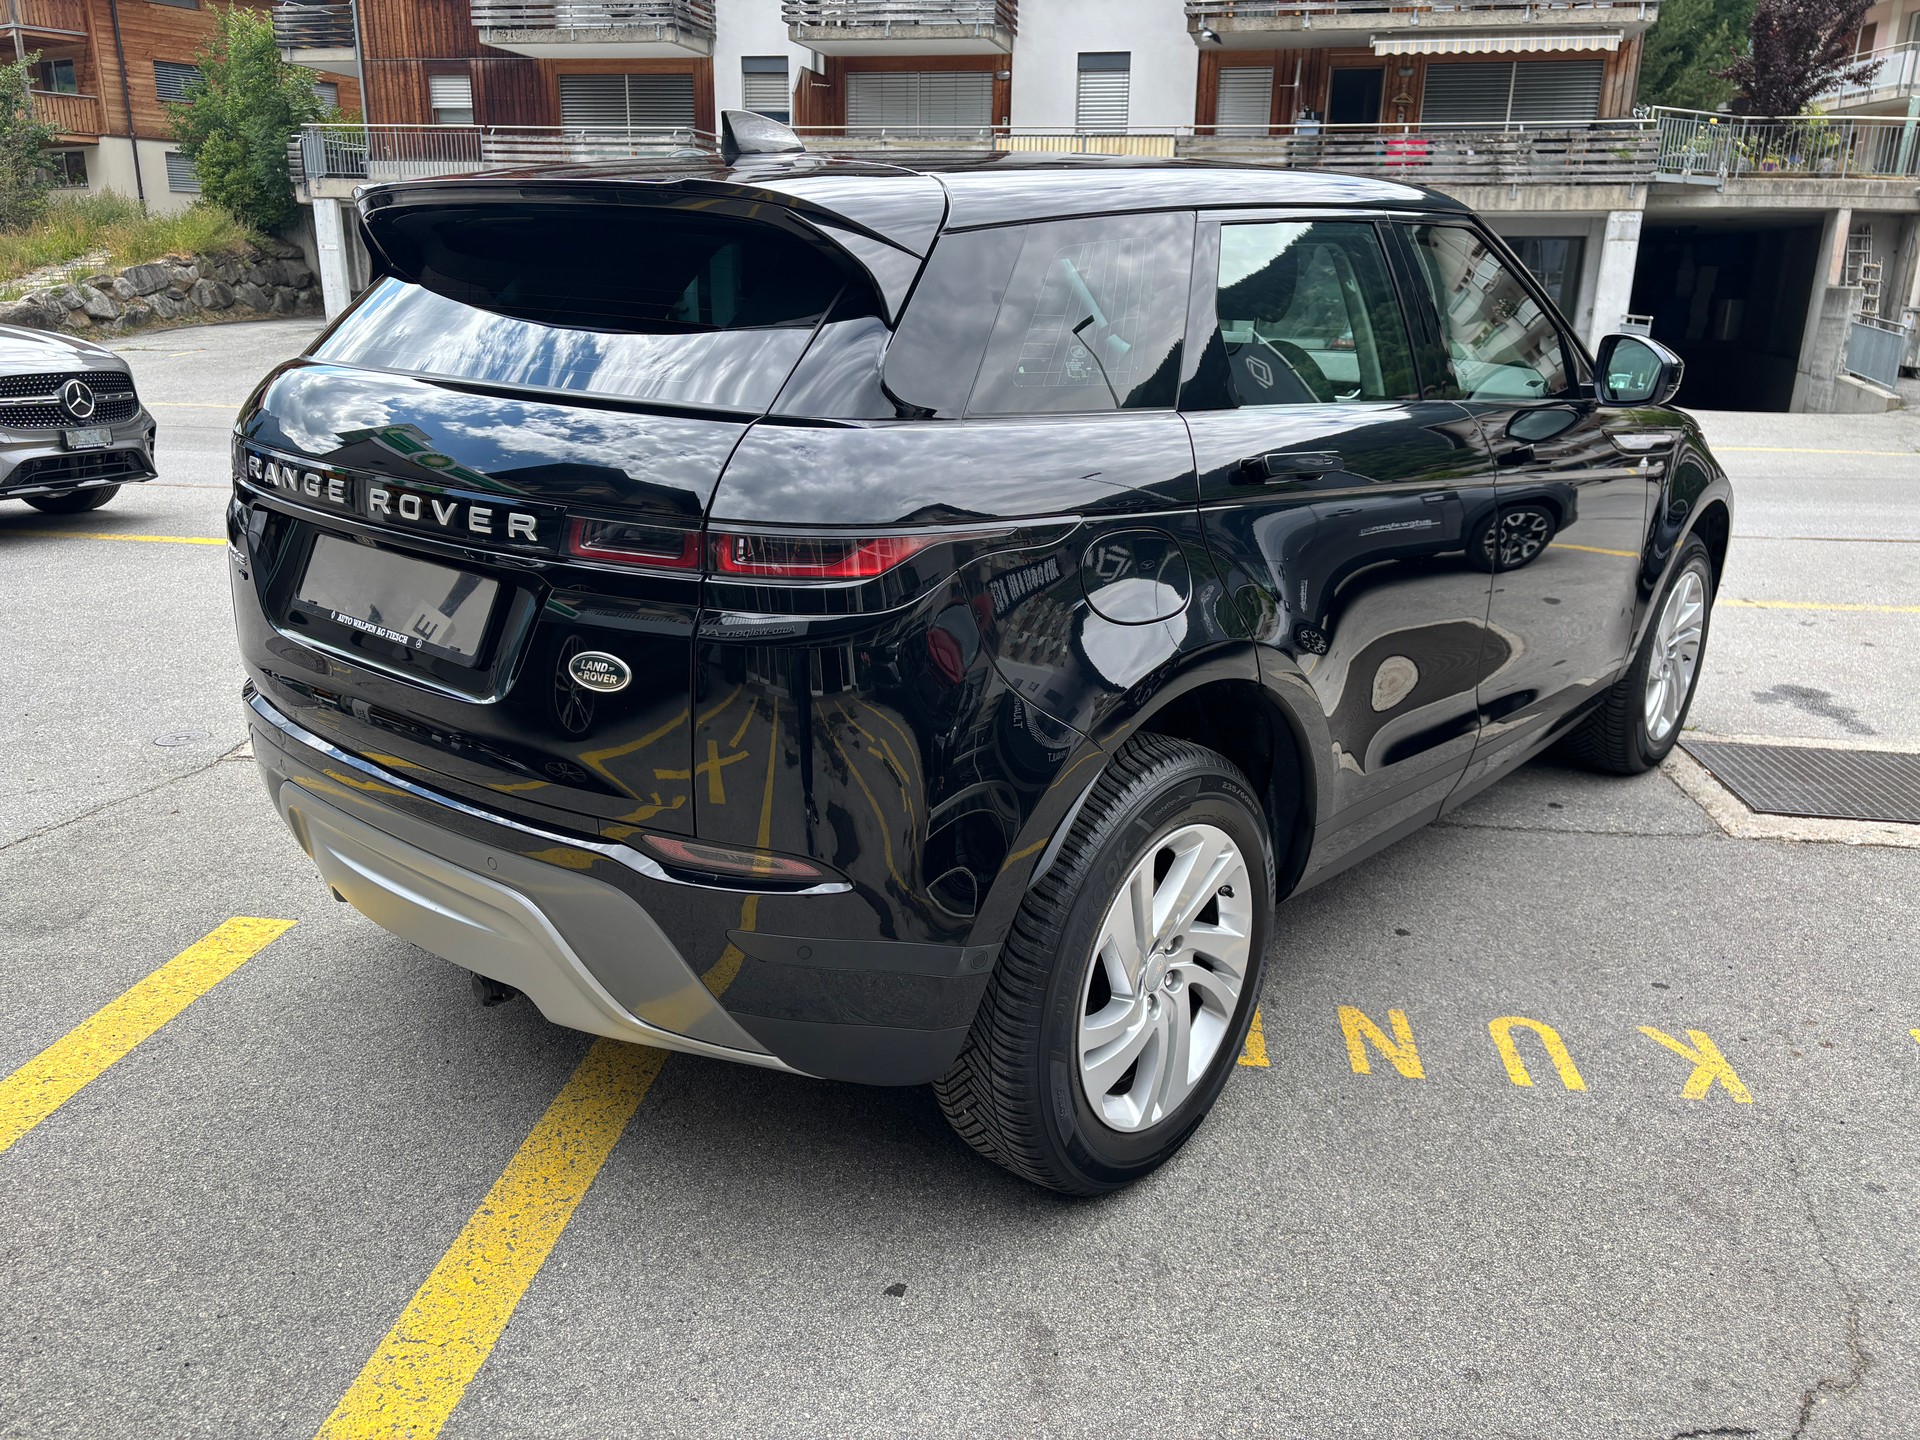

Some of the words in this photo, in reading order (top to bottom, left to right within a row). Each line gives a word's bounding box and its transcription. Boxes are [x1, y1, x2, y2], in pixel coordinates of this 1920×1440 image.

[248, 455, 346, 504] RANGE
[369, 487, 538, 542] ROVER
[337, 613, 354, 625] AUTO
[353, 618, 376, 634] WALPEN
[376, 627, 386, 637] AG
[385, 629, 409, 645] FIESCH
[580, 659, 609, 673] LAND
[582, 671, 618, 685] ROVER
[1154, 798, 1177, 818] Rotation
